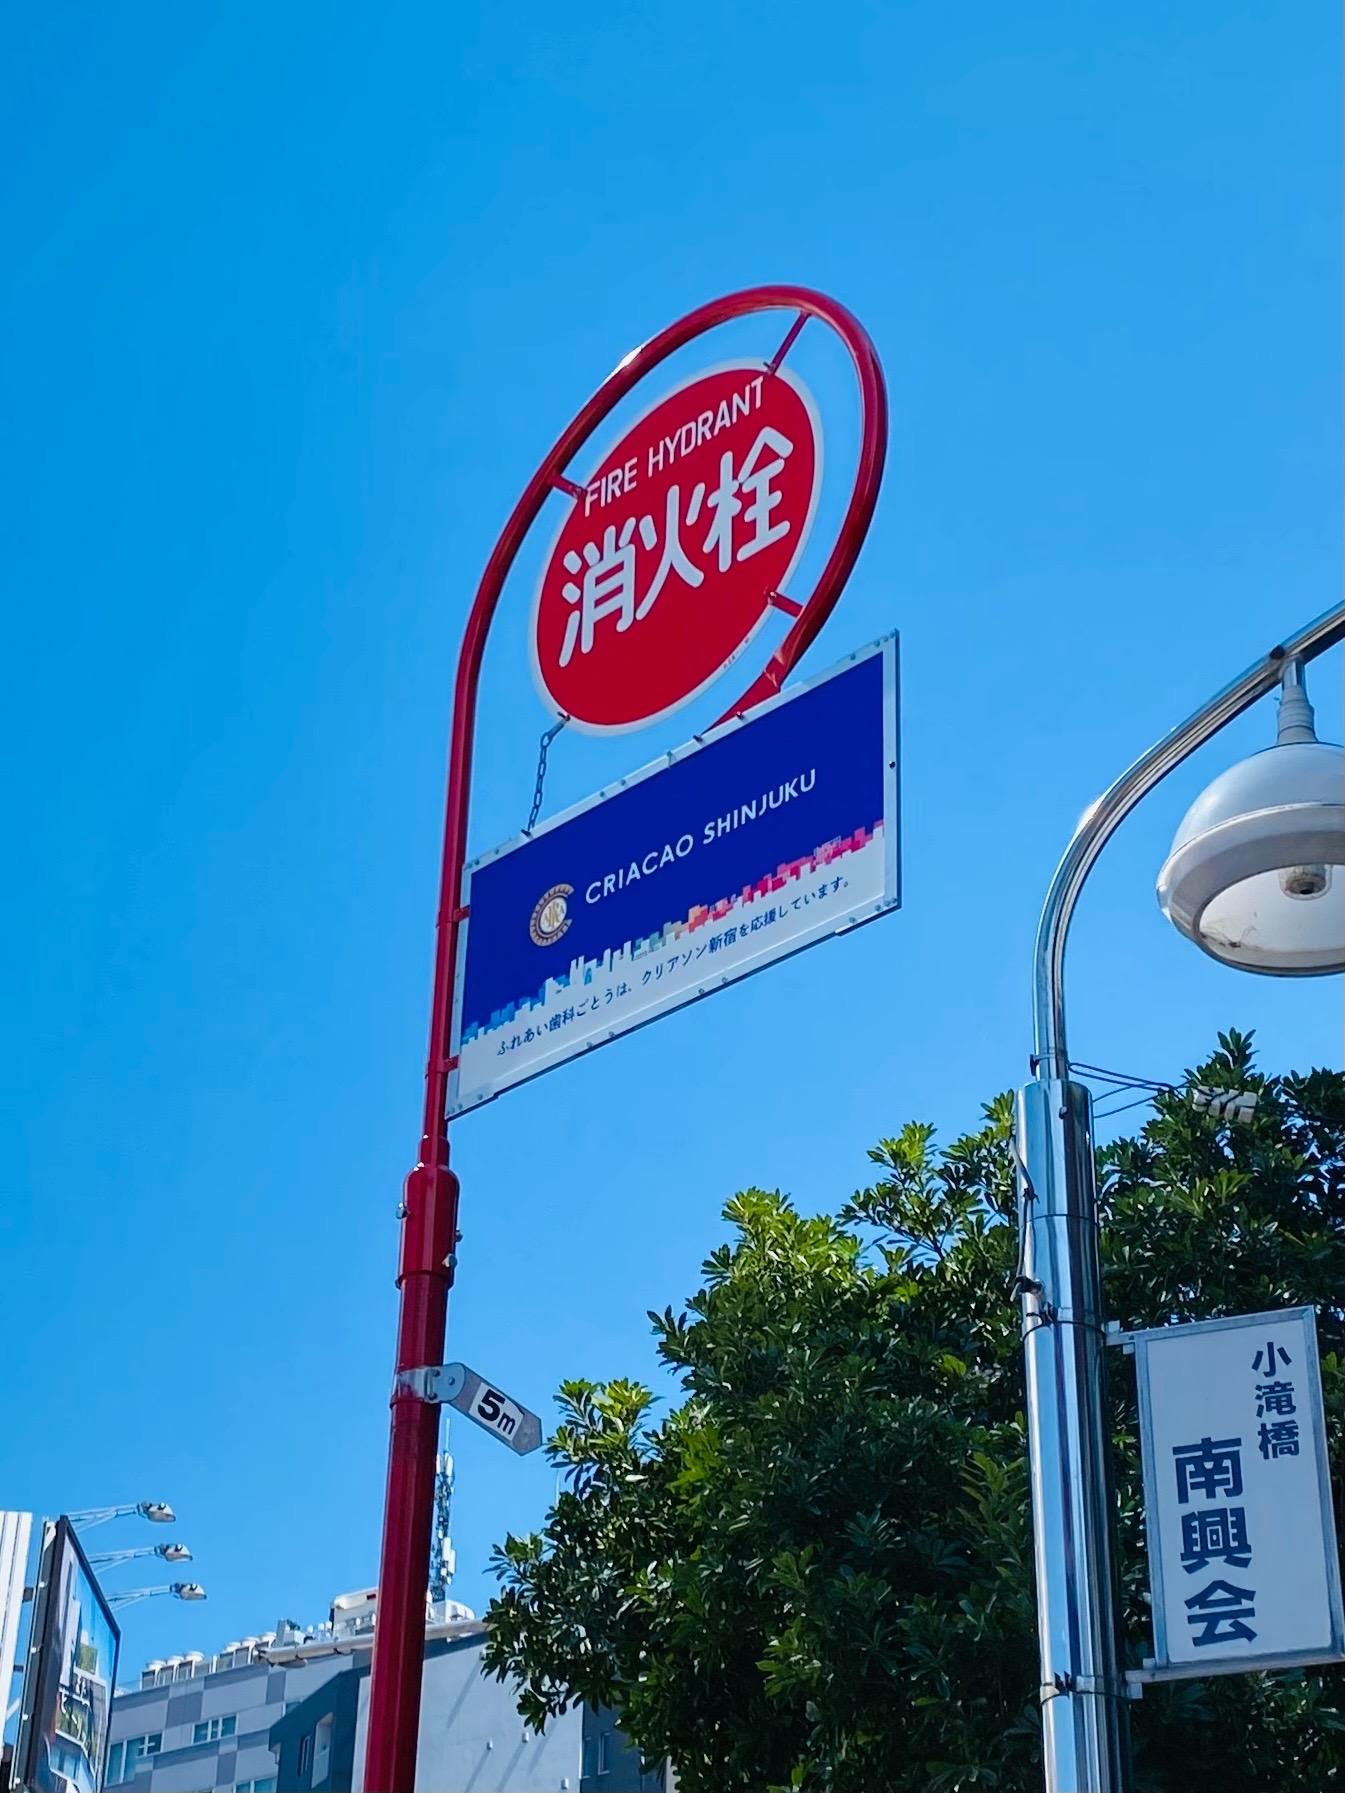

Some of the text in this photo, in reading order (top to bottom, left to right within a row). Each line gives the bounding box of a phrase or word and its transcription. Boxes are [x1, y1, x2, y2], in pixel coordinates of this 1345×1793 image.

[584, 375, 764, 518] FIRE HYDRANT
[561, 426, 794, 668] 消火栓
[585, 768, 817, 905] CRIACAO SHINJUKU
[477, 1388, 516, 1435] 5m
[1251, 1341, 1300, 1460] 小滝橋
[1172, 1436, 1258, 1647] 南興会
